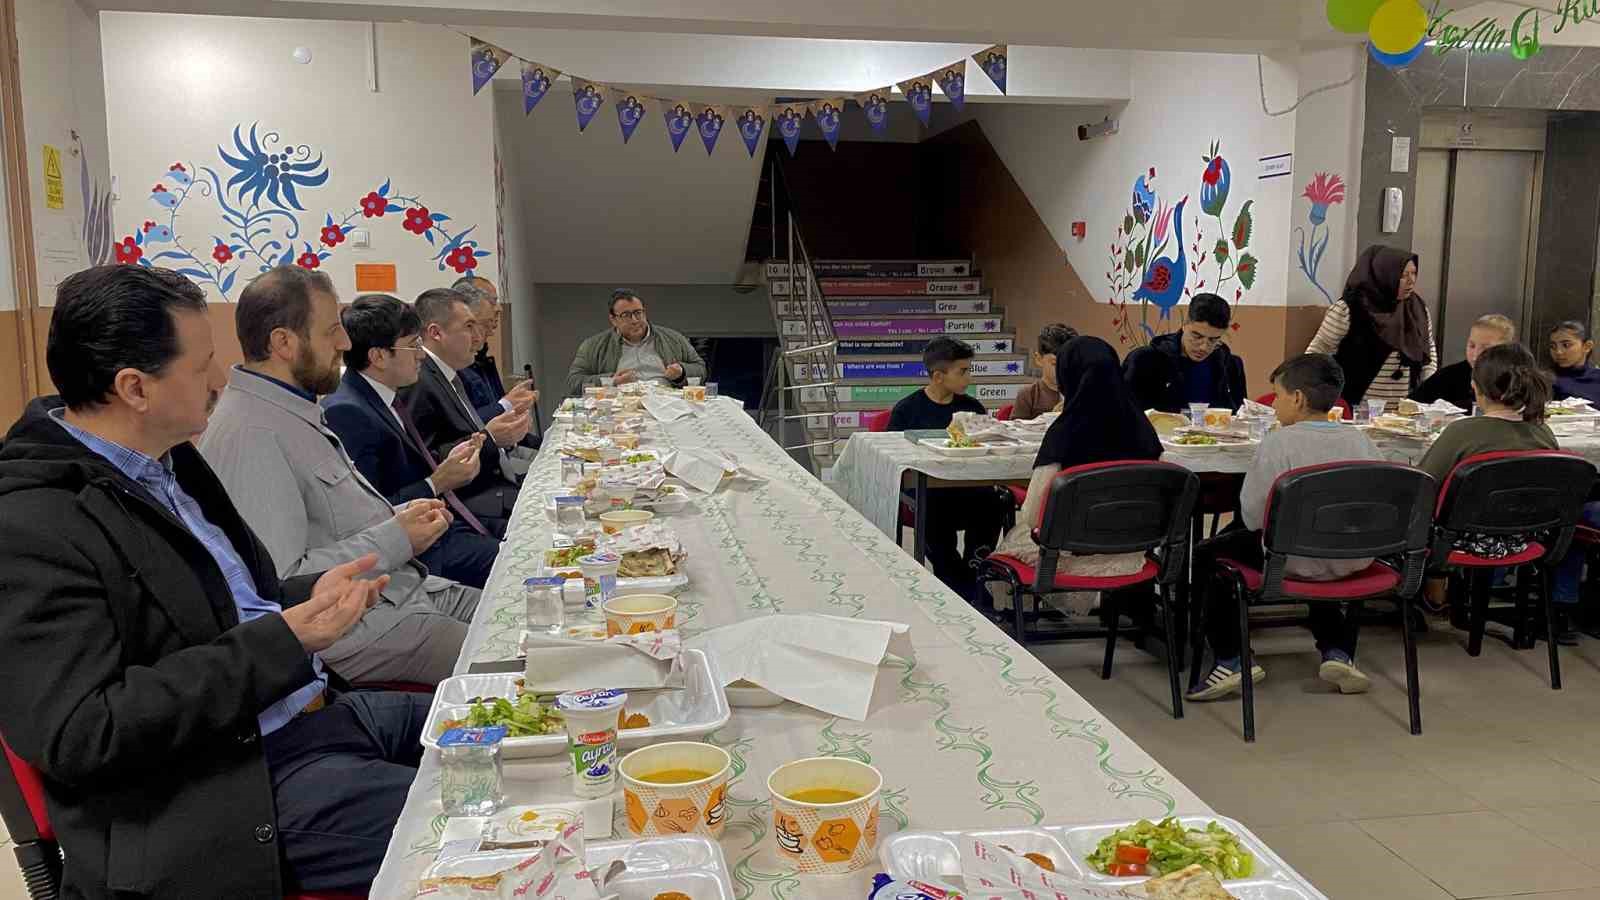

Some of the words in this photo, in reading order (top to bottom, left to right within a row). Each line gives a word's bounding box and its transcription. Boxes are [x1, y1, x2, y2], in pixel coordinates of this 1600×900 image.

[948, 321, 975, 332] Purple
[979, 387, 1008, 397] Green
[581, 743, 616, 769] ayran
